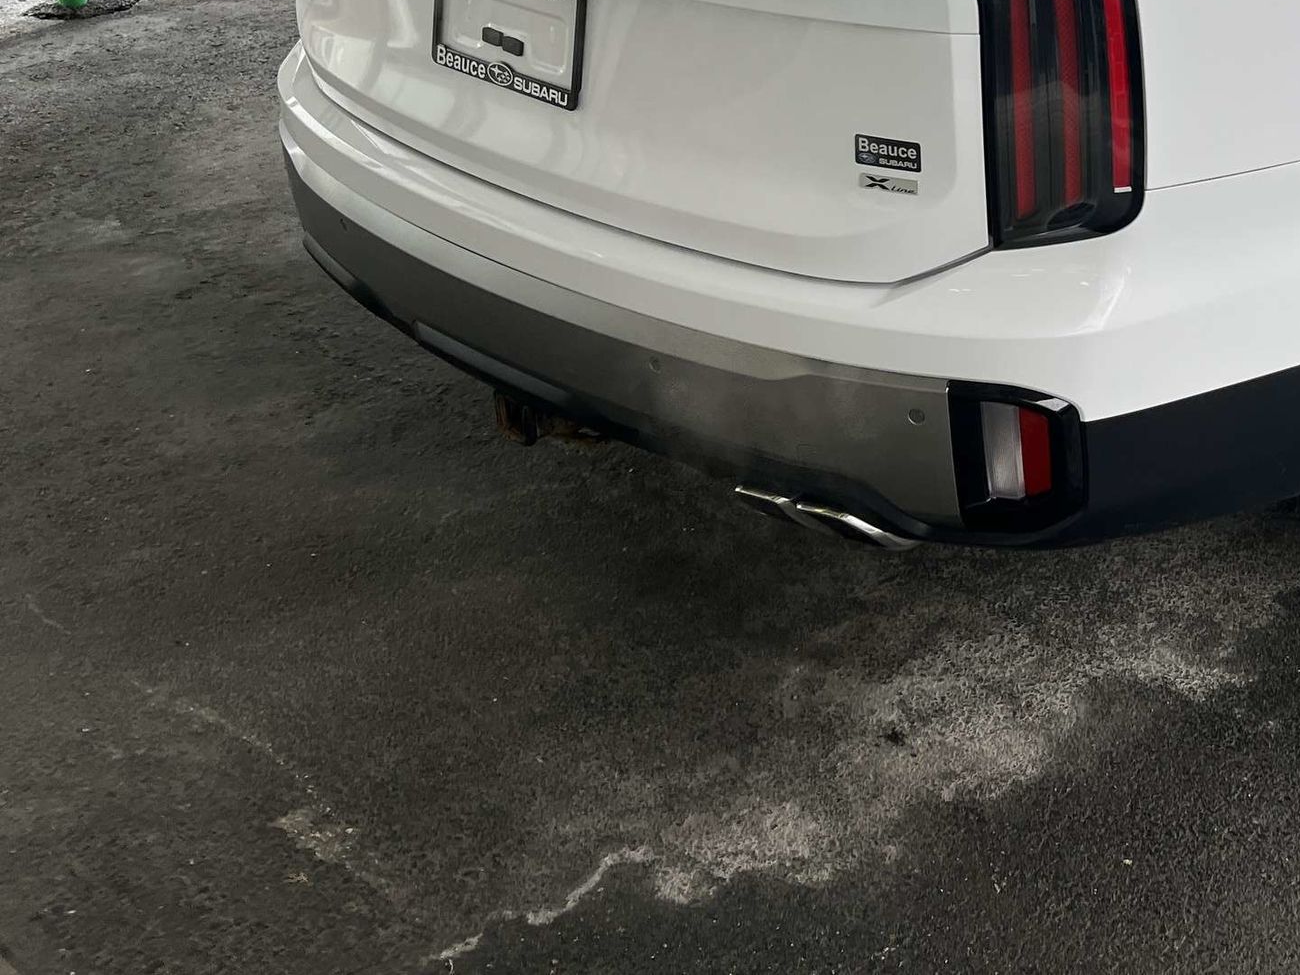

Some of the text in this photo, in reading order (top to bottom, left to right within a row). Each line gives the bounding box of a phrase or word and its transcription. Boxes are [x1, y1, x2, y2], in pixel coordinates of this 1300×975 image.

[437, 45, 568, 106] Beauce SUBARU
[858, 137, 917, 159] Beauce
[879, 157, 917, 169] SUBARU
